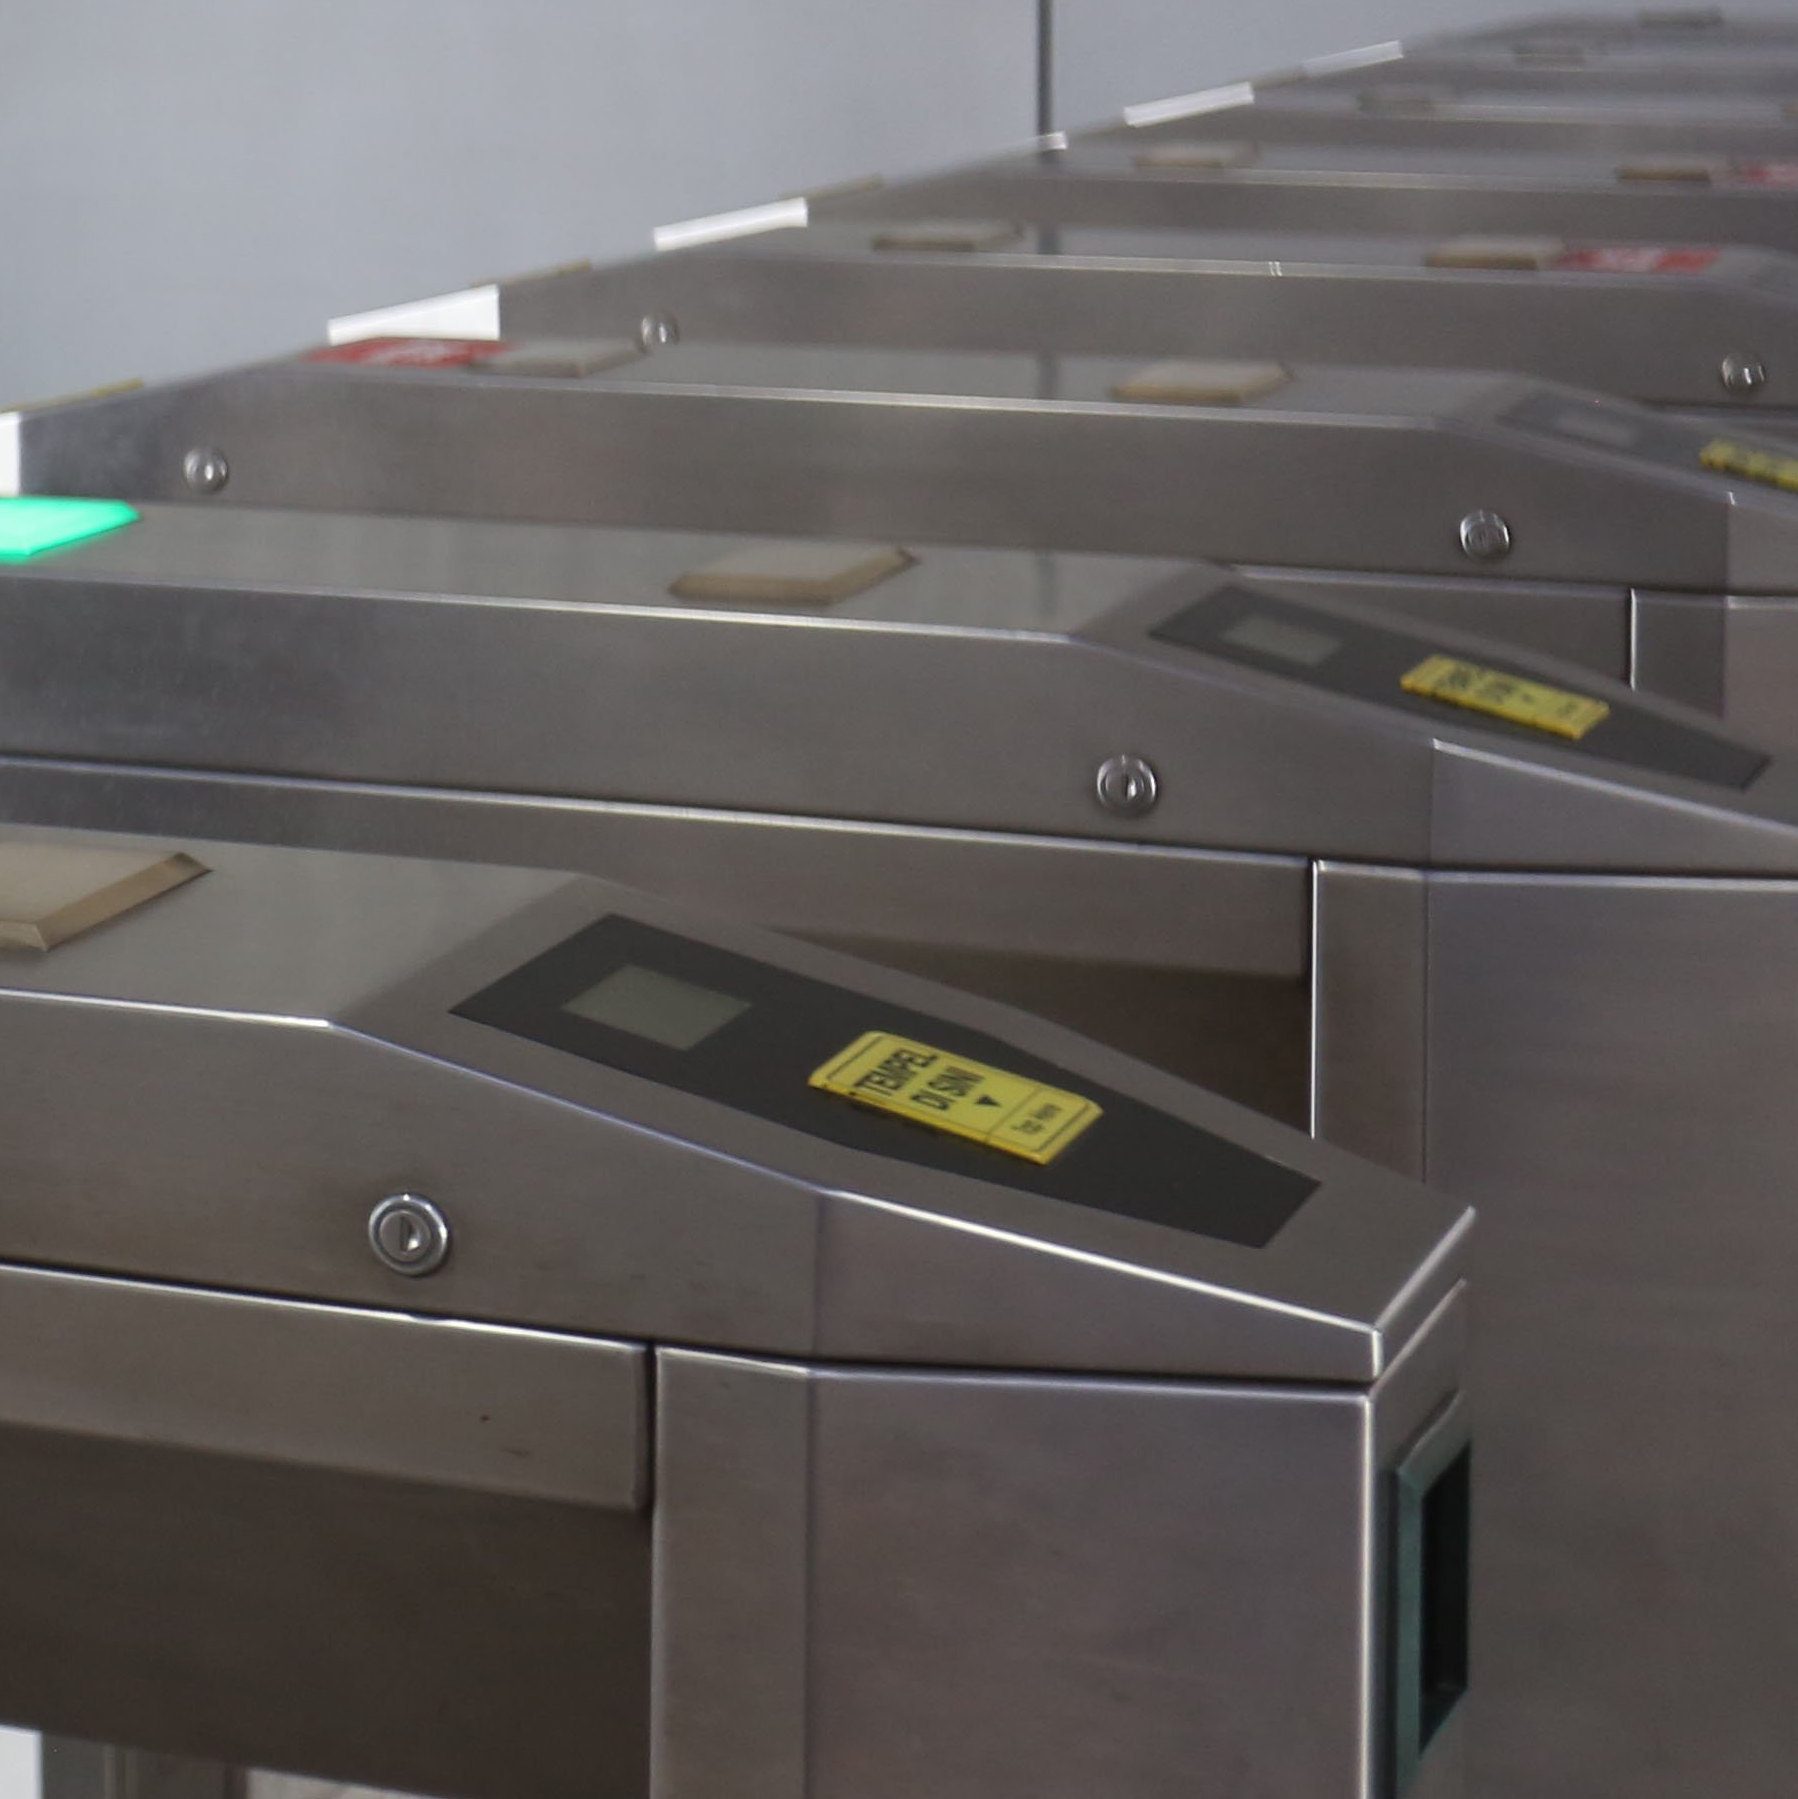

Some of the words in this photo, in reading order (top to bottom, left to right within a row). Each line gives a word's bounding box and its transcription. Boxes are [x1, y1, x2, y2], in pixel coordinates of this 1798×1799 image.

[854, 1047, 939, 1097] TEMPEL
[928, 1065, 985, 1097] SINI
[909, 1087, 956, 1112] DI
